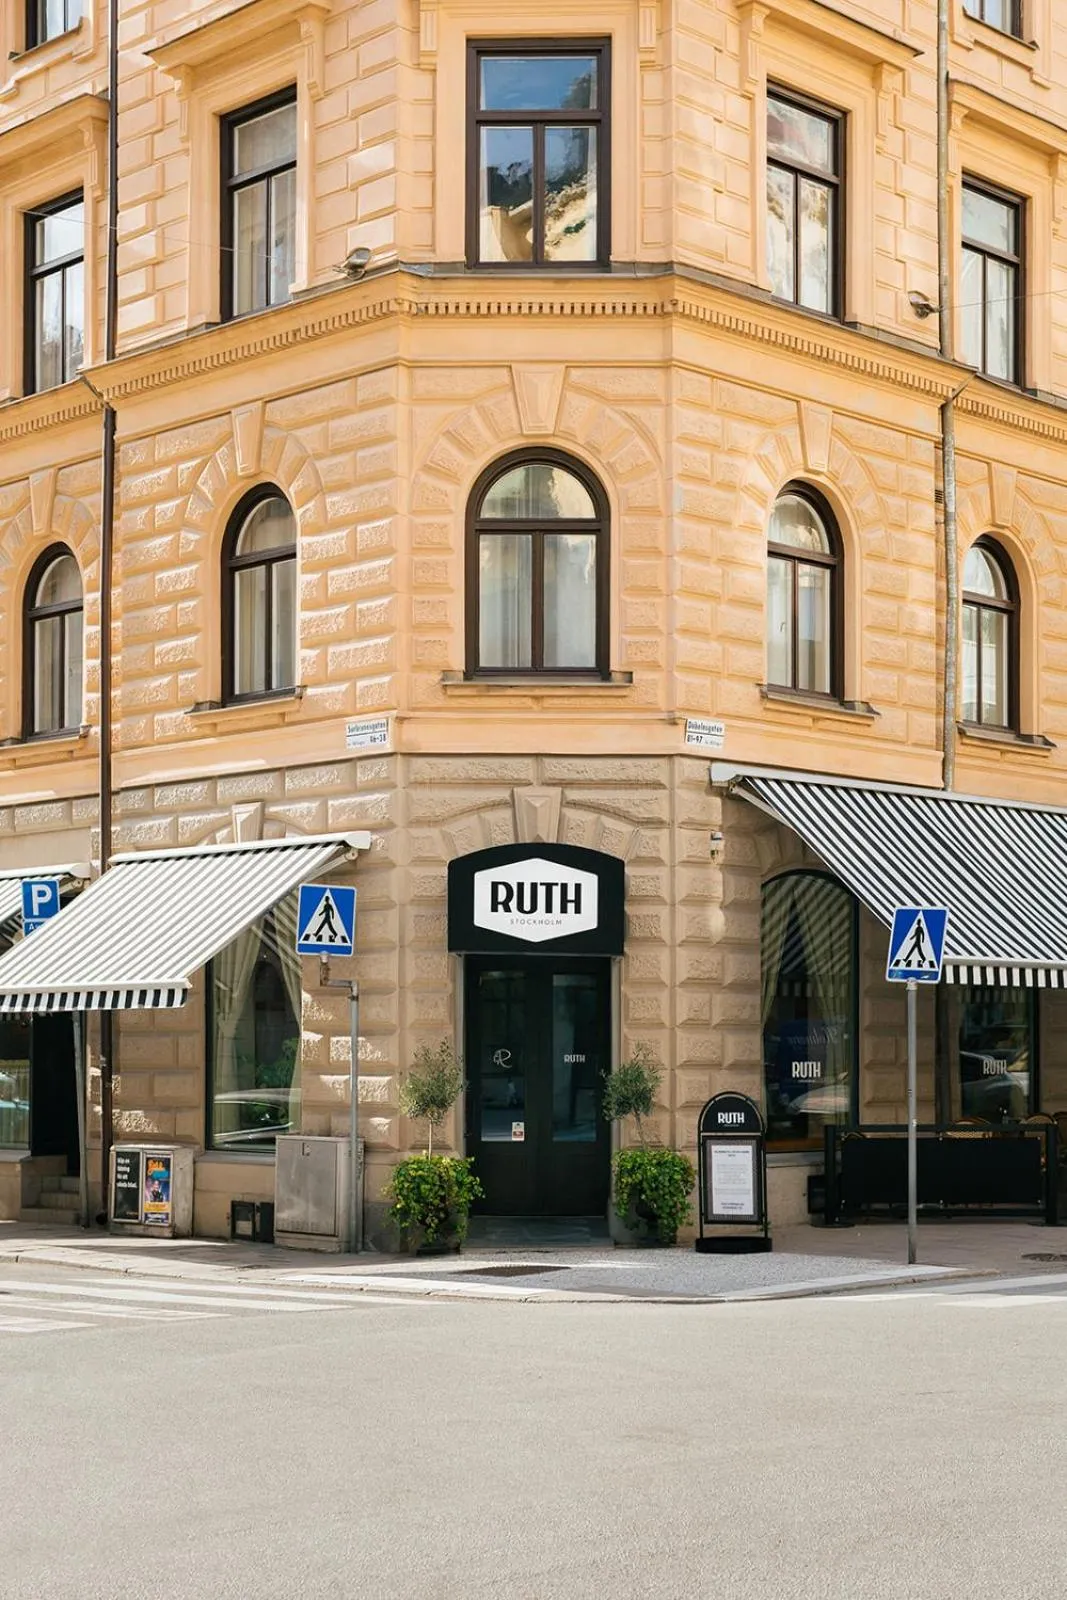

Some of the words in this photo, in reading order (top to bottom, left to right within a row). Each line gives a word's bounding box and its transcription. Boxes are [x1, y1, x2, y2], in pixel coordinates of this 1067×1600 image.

[31, 884, 52, 916] P
[490, 880, 582, 914] RUTH
[563, 1054, 586, 1063] RUTH
[791, 1061, 821, 1078] RUTH
[983, 1059, 1007, 1075] RUTH
[717, 1111, 745, 1124] RUTH
